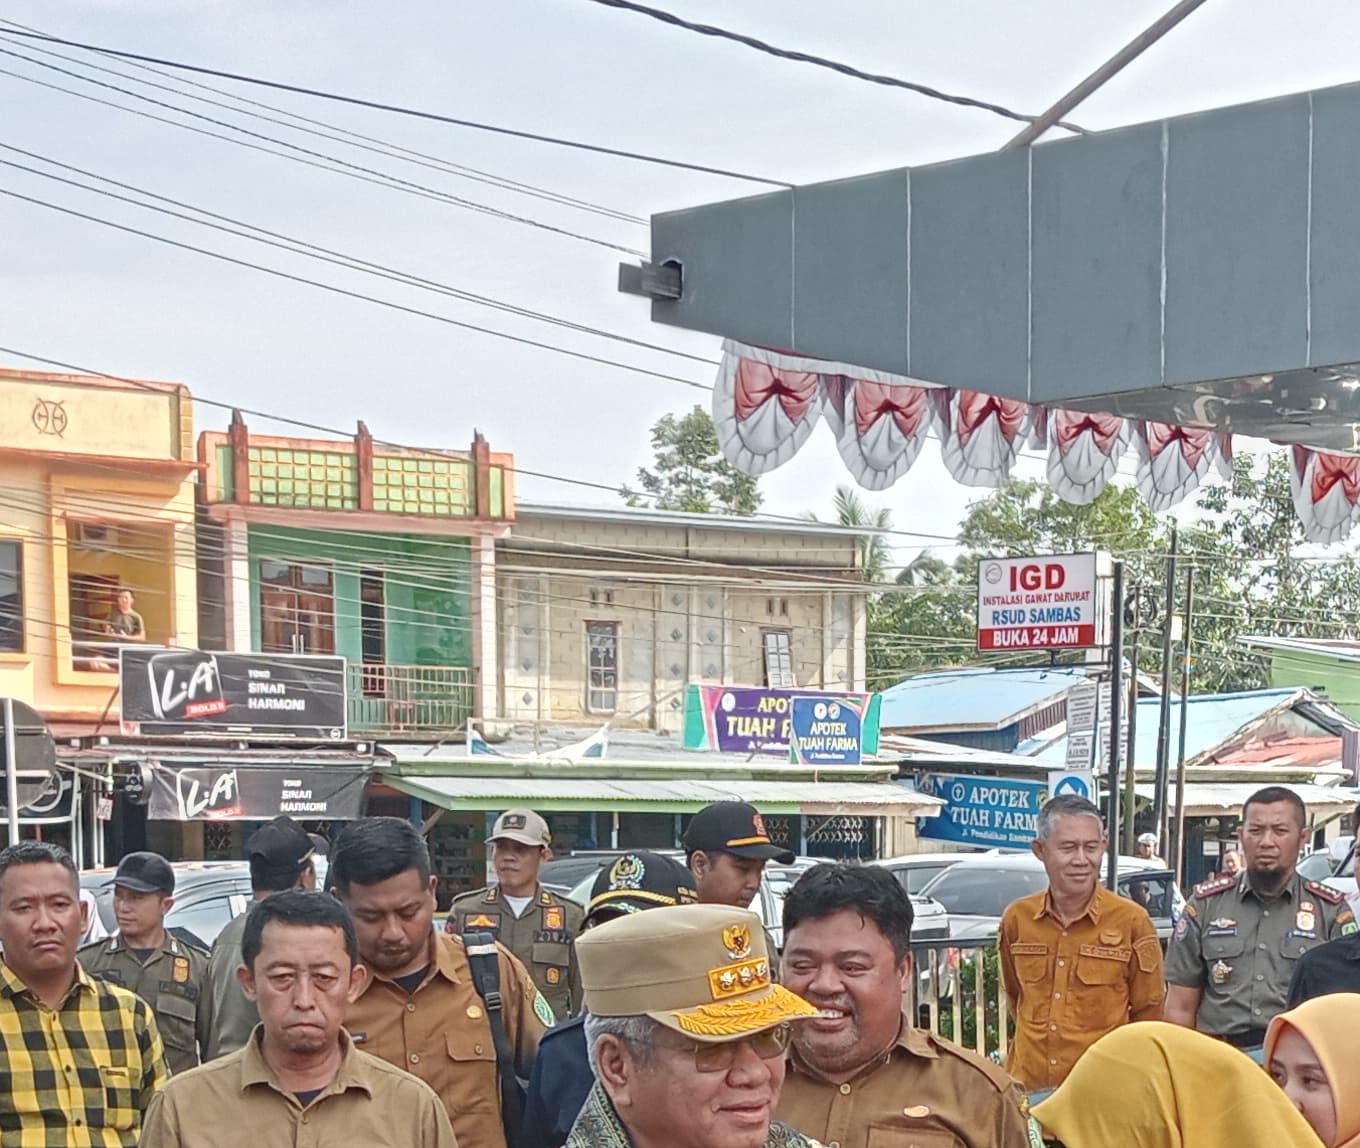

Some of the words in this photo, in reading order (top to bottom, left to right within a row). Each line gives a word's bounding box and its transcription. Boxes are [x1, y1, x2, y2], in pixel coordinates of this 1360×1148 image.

[1009, 563, 1066, 593] IGD
[983, 594, 1023, 606] INSTALASI
[1025, 592, 1053, 605] GAWAT
[1054, 590, 1090, 603] DARURAT
[992, 609, 1026, 626] RSUD
[1029, 606, 1081, 624] SAMBAS
[993, 629, 1030, 647] BUKA
[1032, 628, 1049, 645] 24
[1050, 626, 1080, 644] JAM
[248, 682, 286, 695] SINAR
[248, 699, 306, 711] HARMONI
[810, 721, 847, 736] APOTEK
[799, 737, 825, 751] TUAH
[826, 737, 858, 751] FARMA
[969, 786, 1030, 809] APOTEK
[951, 806, 990, 827] TUAH
[994, 810, 1038, 831] FARM
